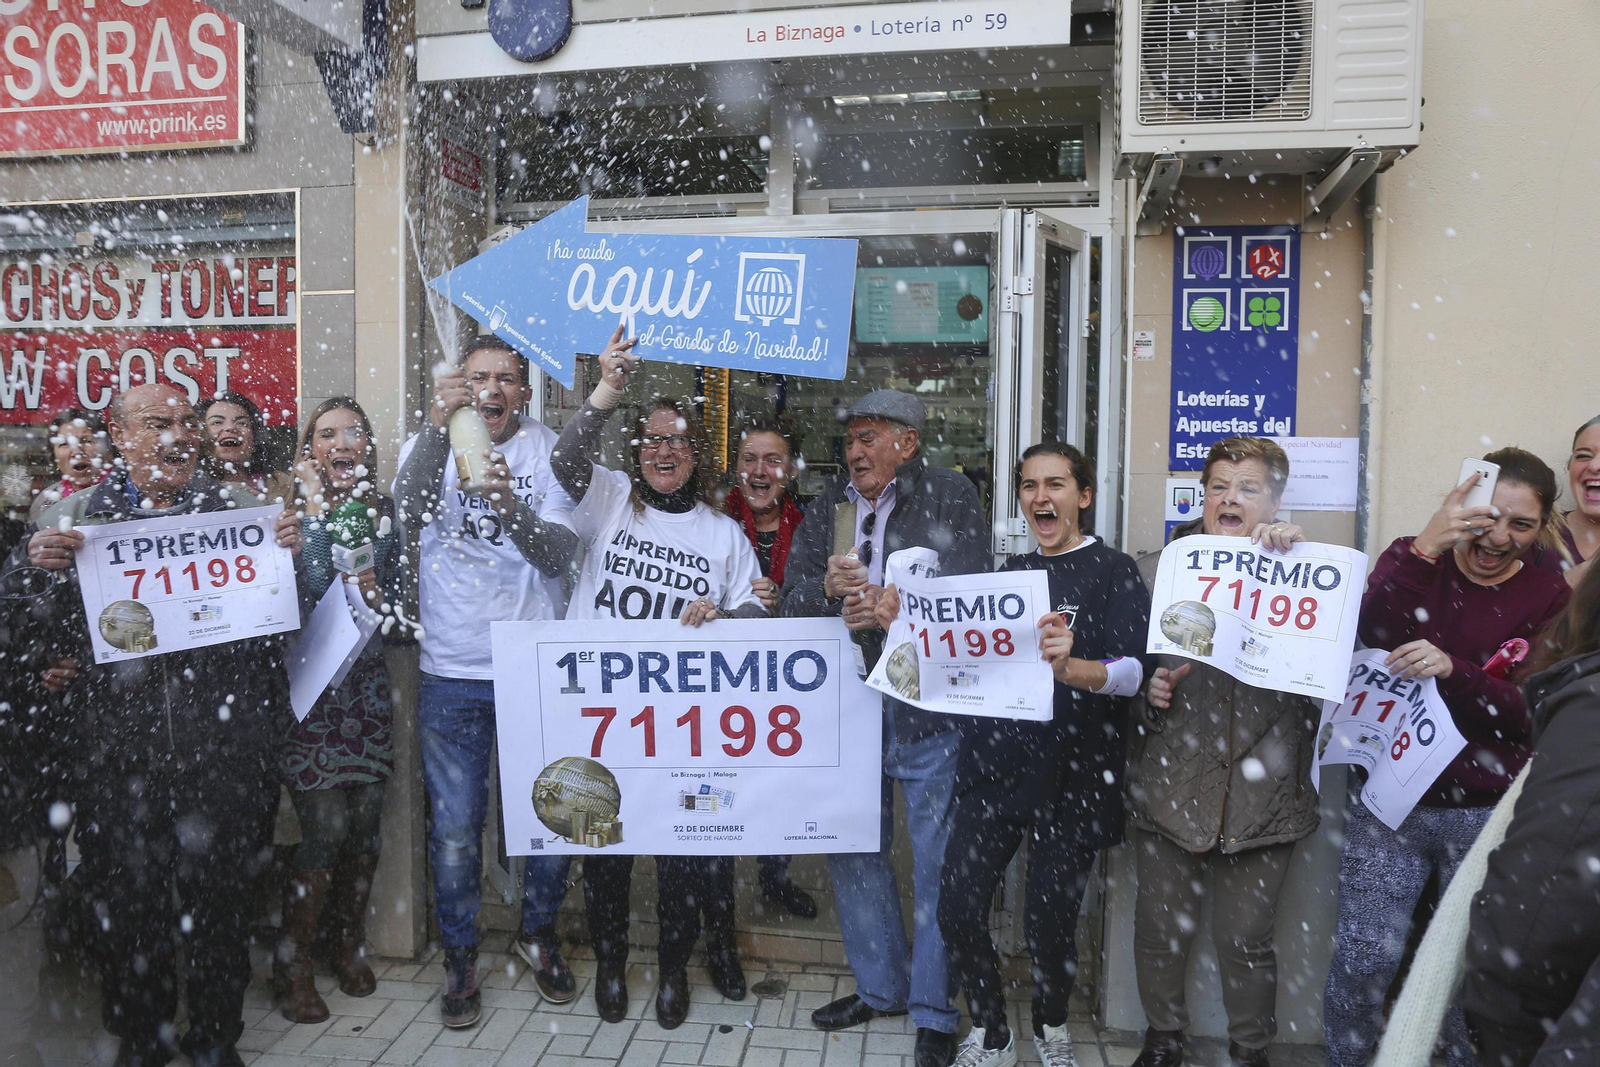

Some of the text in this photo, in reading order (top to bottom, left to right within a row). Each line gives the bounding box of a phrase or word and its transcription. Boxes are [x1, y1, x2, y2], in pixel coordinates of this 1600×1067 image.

[745, 27, 767, 43] La
[776, 23, 846, 43] Biznaga
[870, 15, 941, 37] Lotería
[985, 13, 1008, 30] 59
[3, 13, 227, 101] SORAS
[96, 112, 227, 138] www.prink.es
[2, 260, 121, 324] CHOS
[502, 322, 563, 370] Apuestas del Estado
[639, 325, 830, 362] el Gordo de Navidad!
[1176, 389, 1266, 411] Loterías y
[1175, 416, 1291, 437] Apuestas del
[1279, 440, 1343, 449] Especial Navidad
[1175, 442, 1212, 459] Esta
[133, 523, 265, 563] PREMIO
[459, 512, 504, 546] AQ
[604, 550, 710, 597] VENDIDO
[625, 534, 711, 574] PREMIO
[1186, 548, 1342, 592] 1er PREMIO
[123, 554, 257, 600] 71198
[906, 592, 1026, 624] PREMIO
[1197, 575, 1319, 631] 71198
[555, 648, 829, 695] 1er PREMIO
[580, 704, 804, 758] 71198
[673, 824, 745, 832] 22 DE DICIEMBRE
